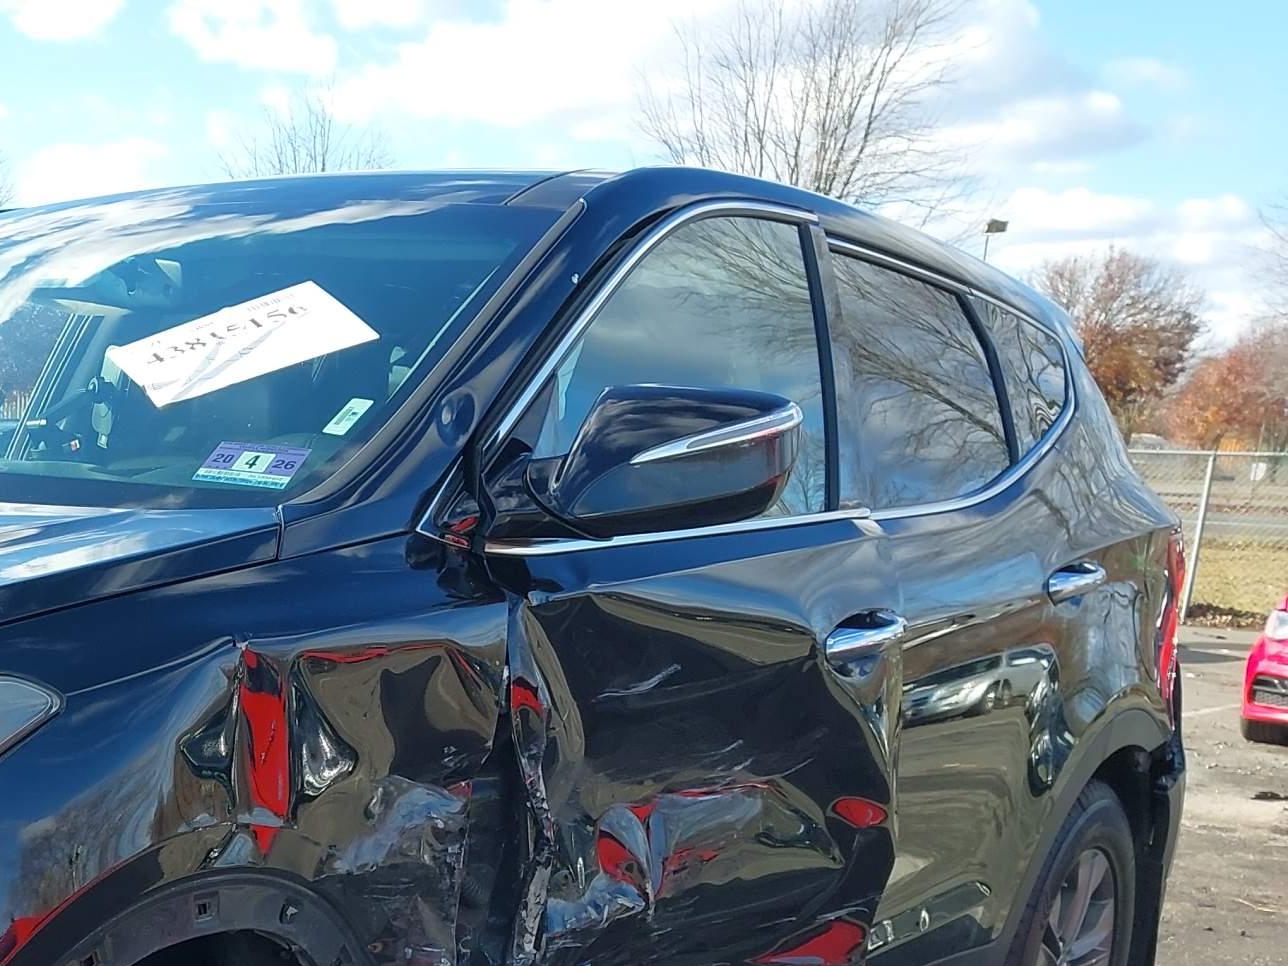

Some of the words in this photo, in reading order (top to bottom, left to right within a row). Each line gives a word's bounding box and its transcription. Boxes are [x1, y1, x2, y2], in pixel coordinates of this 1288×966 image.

[211, 453, 235, 464] 20
[244, 454, 262, 469] 4
[271, 459, 297, 470] 26
